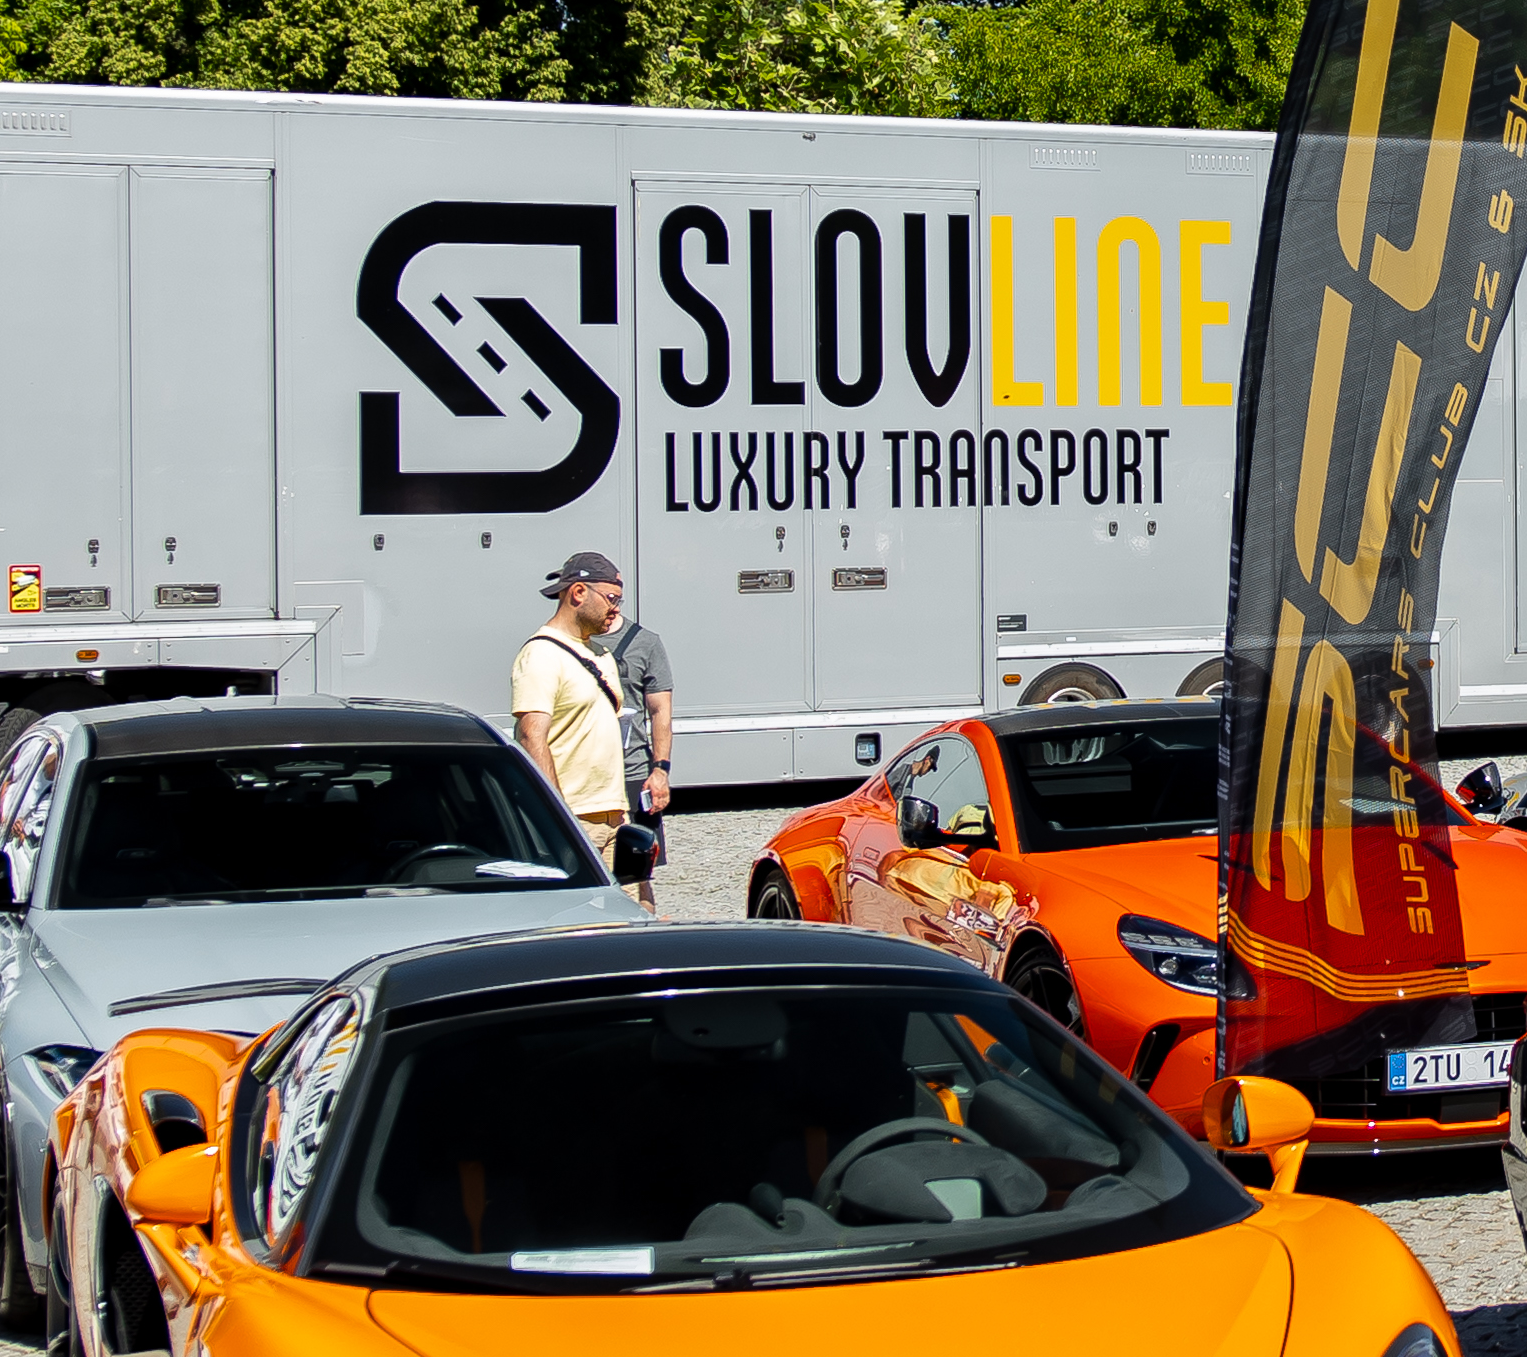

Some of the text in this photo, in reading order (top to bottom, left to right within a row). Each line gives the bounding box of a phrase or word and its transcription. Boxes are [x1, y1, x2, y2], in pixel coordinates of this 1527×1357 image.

[658, 203, 1234, 408] SLOVLINE
[664, 428, 1170, 513] LUXURY TRANSPORT
[1384, 591, 1435, 936] SUPERCARS
[1410, 379, 1468, 560] CLUB
[1466, 261, 1500, 354] CZ
[1488, 191, 1512, 235] &
[1391, 1075, 1406, 1086] CZ
[1413, 1053, 1461, 1084] 2TU
